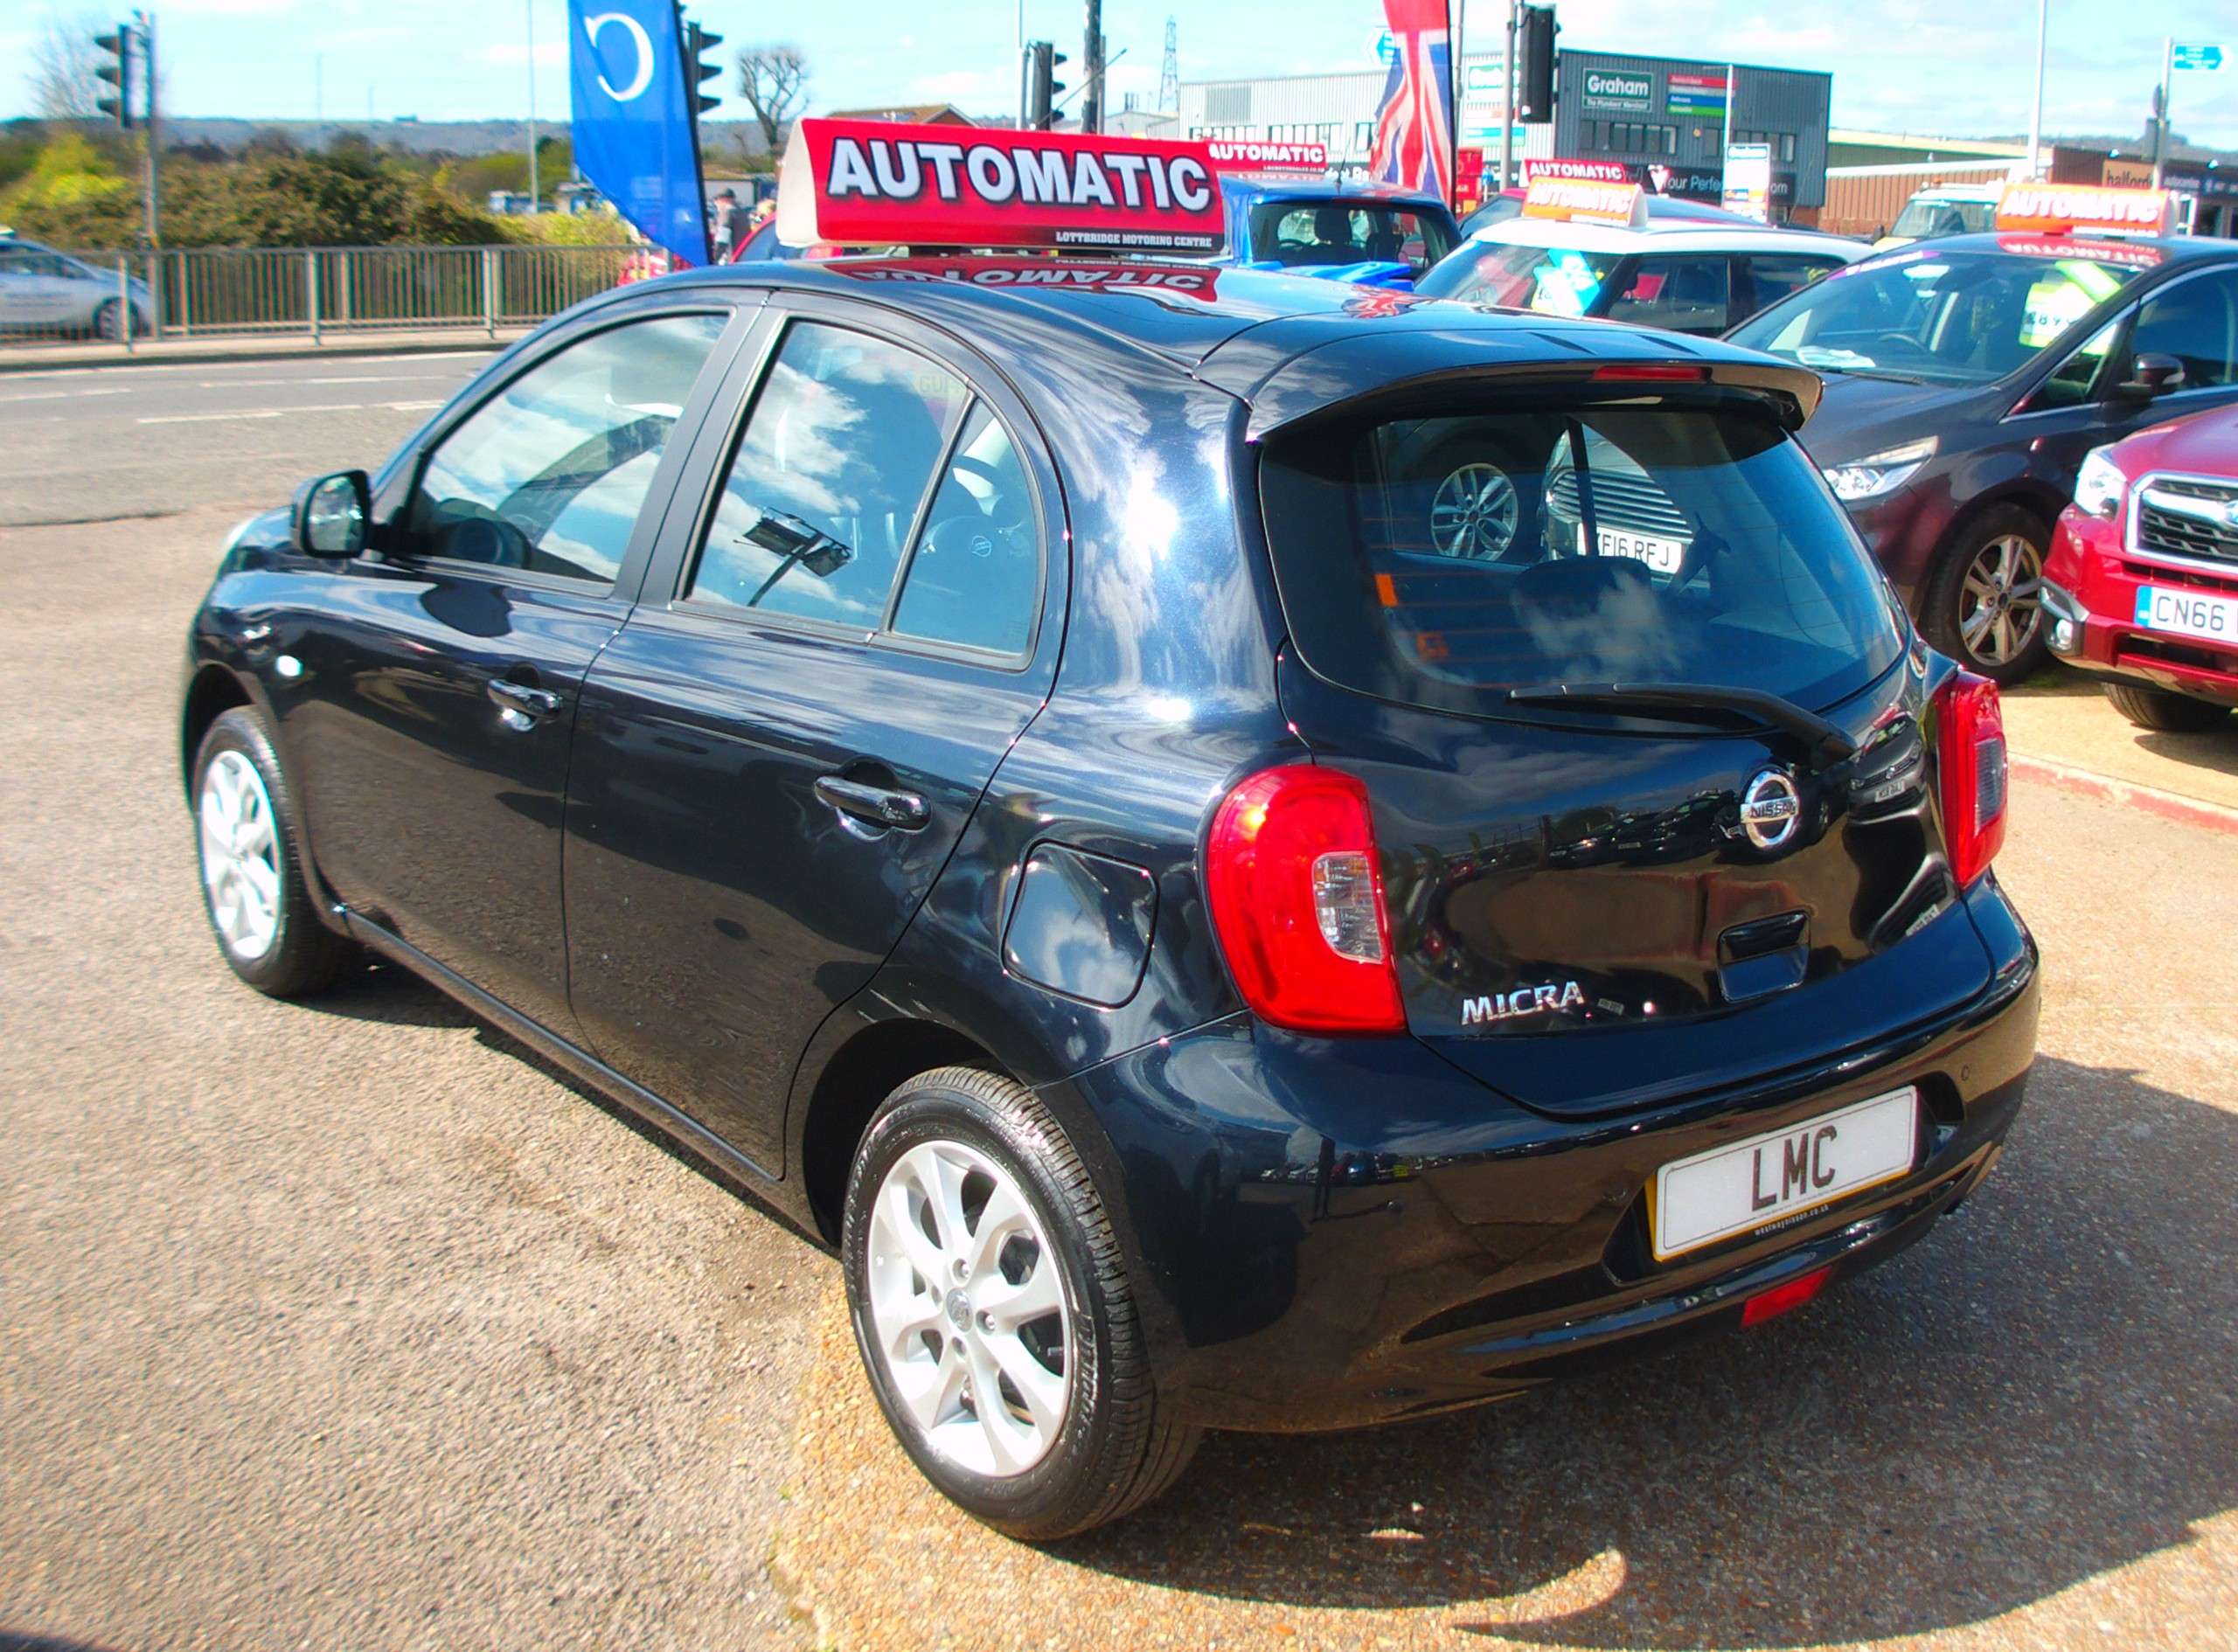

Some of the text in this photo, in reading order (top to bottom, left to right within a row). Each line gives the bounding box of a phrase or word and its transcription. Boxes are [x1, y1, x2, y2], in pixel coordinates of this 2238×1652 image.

[1588, 74, 1649, 97] Graham
[1209, 143, 1324, 163] AUTOMATIC
[827, 136, 1212, 212] AUTOMATIC
[1530, 162, 1623, 180] AUTOMATIC
[1529, 182, 1632, 214] AUTOMATIC
[2001, 190, 2160, 223] AUTOMATIC
[1055, 231, 1213, 247] LOTTBRIDGE MOTORING CENTRE
[2156, 595, 2226, 632] CN66
[1750, 802, 1797, 819] NISSAN
[1461, 980, 1585, 1025] MICRA
[1751, 1125, 1838, 1211] LMC
